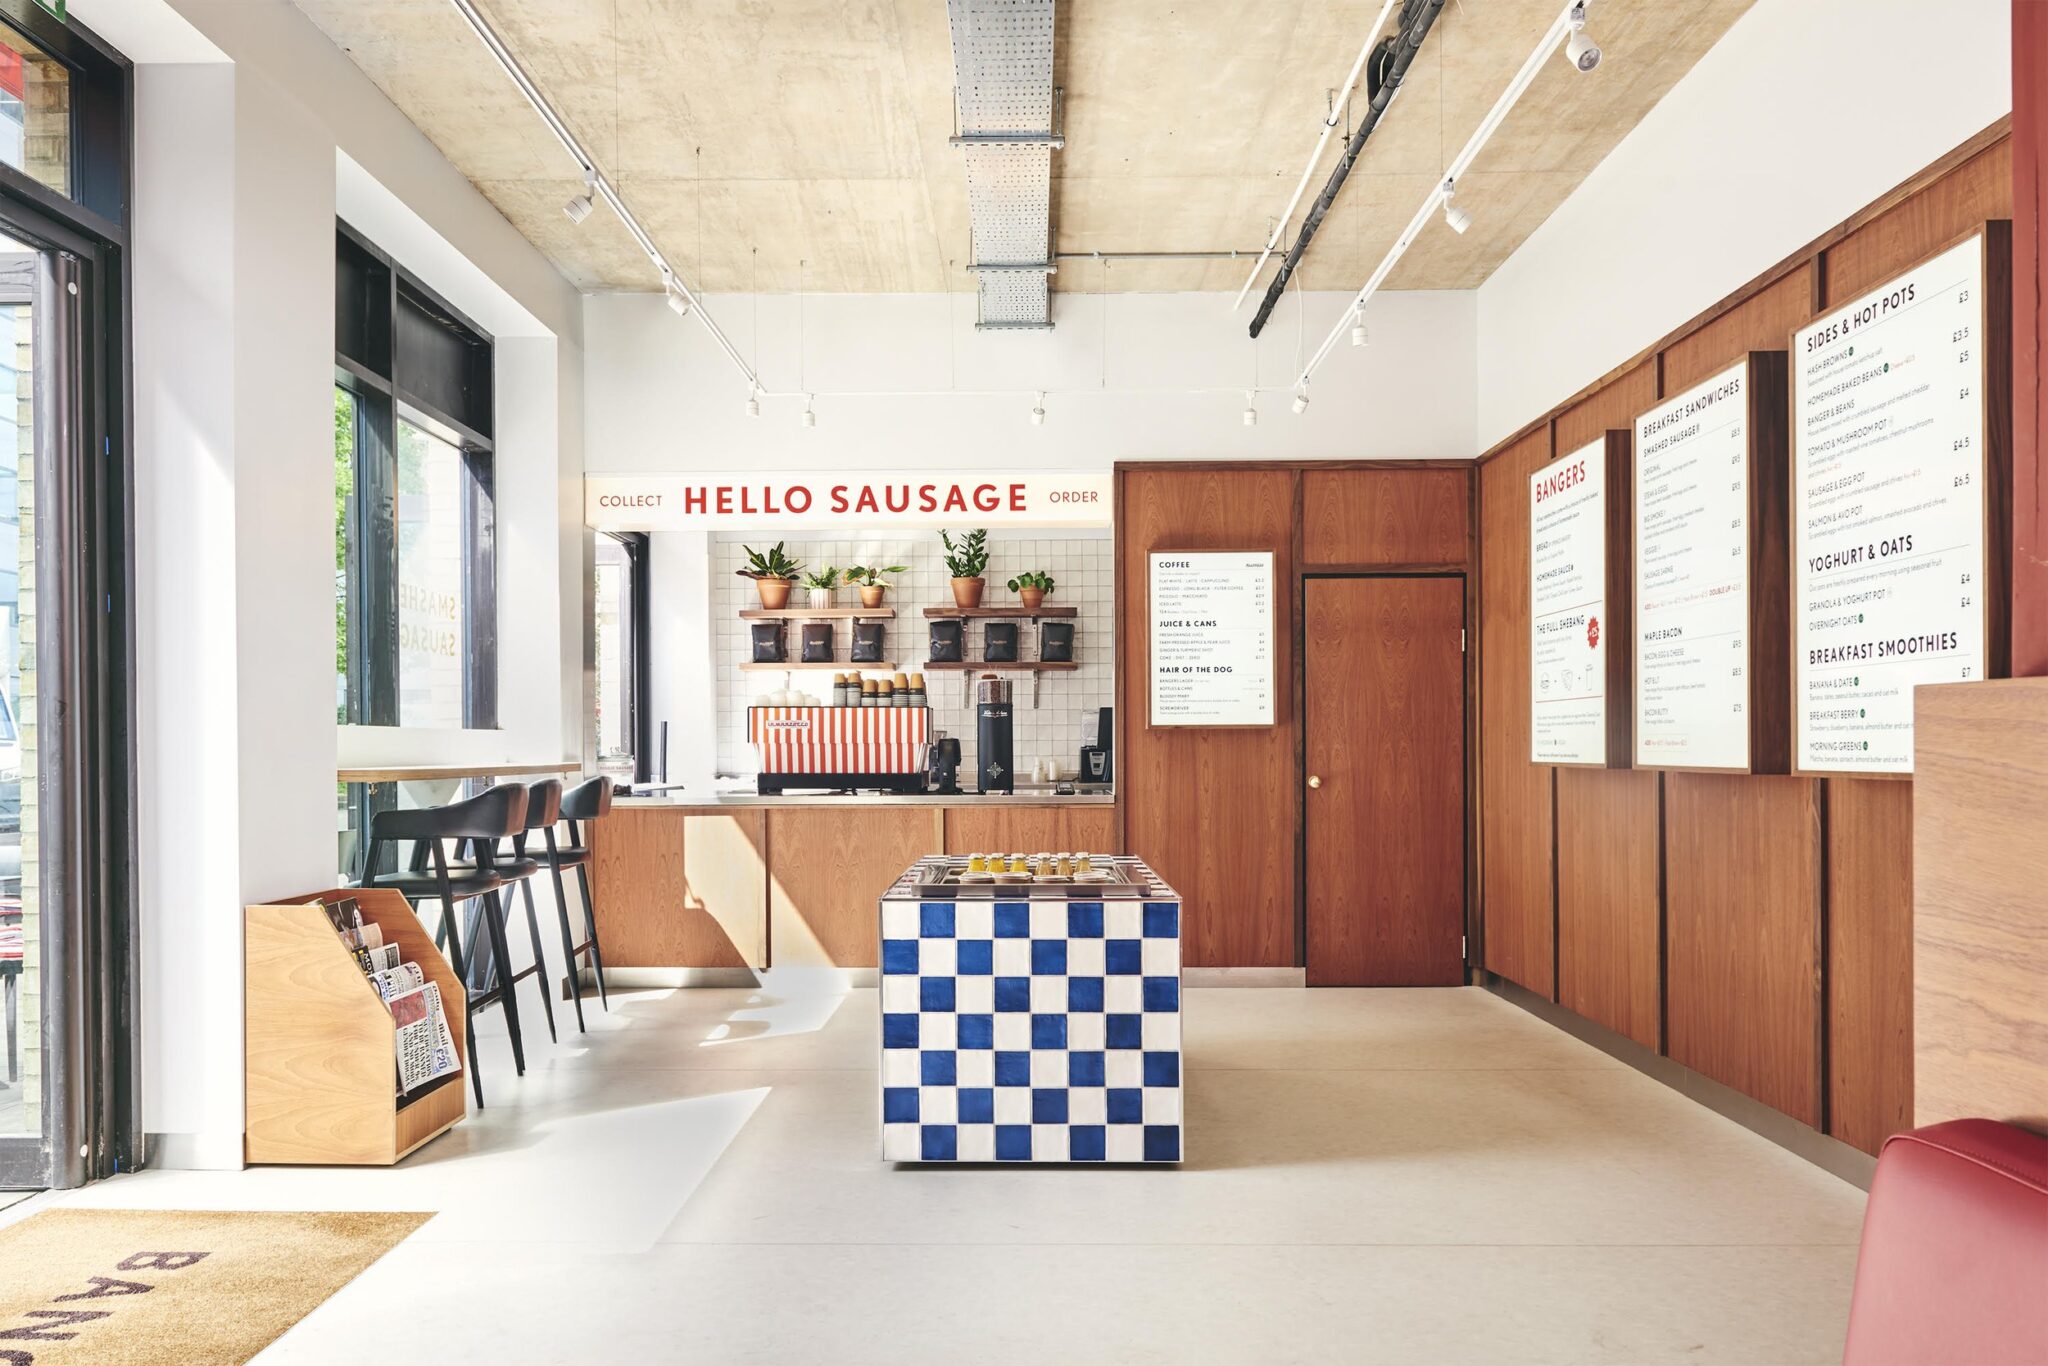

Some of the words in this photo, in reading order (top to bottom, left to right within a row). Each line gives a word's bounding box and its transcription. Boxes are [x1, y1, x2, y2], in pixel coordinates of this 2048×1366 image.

[1959, 290, 1968, 303] £3
[1808, 324, 1838, 352] SIDES
[1842, 319, 1849, 334] &
[1854, 303, 1877, 329] HOT
[1883, 283, 1914, 314] POTS
[1953, 327, 1968, 343] £3.5
[1807, 364, 1822, 375] HASH
[1823, 350, 1847, 369] BROWNS
[1960, 350, 1968, 363] £5
[1807, 385, 1840, 406] HOMEMADE
[1842, 376, 1861, 392] BAKED
[1862, 366, 1882, 383] BEANS
[1960, 388, 1969, 399] £4
[1644, 408, 1683, 438] BREAKFAST
[1686, 379, 1739, 417] SANDWICHES
[1808, 410, 1830, 426] BANGER
[1831, 408, 1835, 417] &
[1836, 399, 1855, 415] BEANS
[1644, 438, 1668, 458] SMASHED
[1670, 425, 1695, 445] SAUSAGE
[1808, 441, 1830, 456] TOMATO
[1832, 439, 1835, 448] &
[1837, 425, 1873, 444] MUSHROOM
[1875, 419, 1887, 431] POT
[1954, 437, 1969, 451] £4.5
[1536, 460, 1585, 503] BANGERS
[1808, 482, 1833, 499] SAUSAGE
[1834, 481, 1838, 490] &
[1839, 476, 1852, 488] EGG
[1853, 472, 1865, 482] POT
[1954, 473, 1969, 487] £6.5
[600, 495, 662, 507] COLLECT
[684, 486, 810, 514] HELLO
[830, 483, 1026, 514] SAUSAGE
[1049, 490, 1098, 504] ORDER
[1808, 515, 1832, 529] SALMON
[1833, 513, 1837, 522] &
[1838, 509, 1850, 519] AVO
[1851, 505, 1862, 516] POT
[1809, 547, 1863, 573] YOGHURT
[1868, 544, 1875, 560] &
[1880, 535, 1912, 557] OATS
[1961, 574, 1970, 584] £4
[1809, 599, 1837, 612] GRANOLA
[1838, 598, 1841, 607] &
[1843, 591, 1872, 605] YOGHURT
[1873, 589, 1885, 599] POT
[1961, 597, 1970, 607] £4
[1537, 624, 1545, 634] THE
[1547, 623, 1558, 632] FULL
[1560, 614, 1584, 630] SHEBANG
[1809, 617, 1841, 631] OVERNIGHT
[1843, 615, 1857, 626] OATS
[1645, 630, 1661, 640] MAPLE
[1663, 627, 1682, 639] BACON
[1810, 643, 1873, 664] BREAKFAST
[1878, 632, 1957, 657] SMOOTHIES
[1962, 667, 1971, 677] £7
[1809, 680, 1832, 690] BANANA
[1834, 679, 1838, 688] &
[1839, 677, 1853, 688] DATE
[1810, 710, 1839, 720] BREAKFAST
[1841, 709, 1858, 719] BERRY
[1810, 741, 1838, 751] MORNING
[1839, 741, 1862, 751] GREENS
[438, 1023, 449, 1046] Mail
[424, 1034, 432, 1077] EDUCATION
